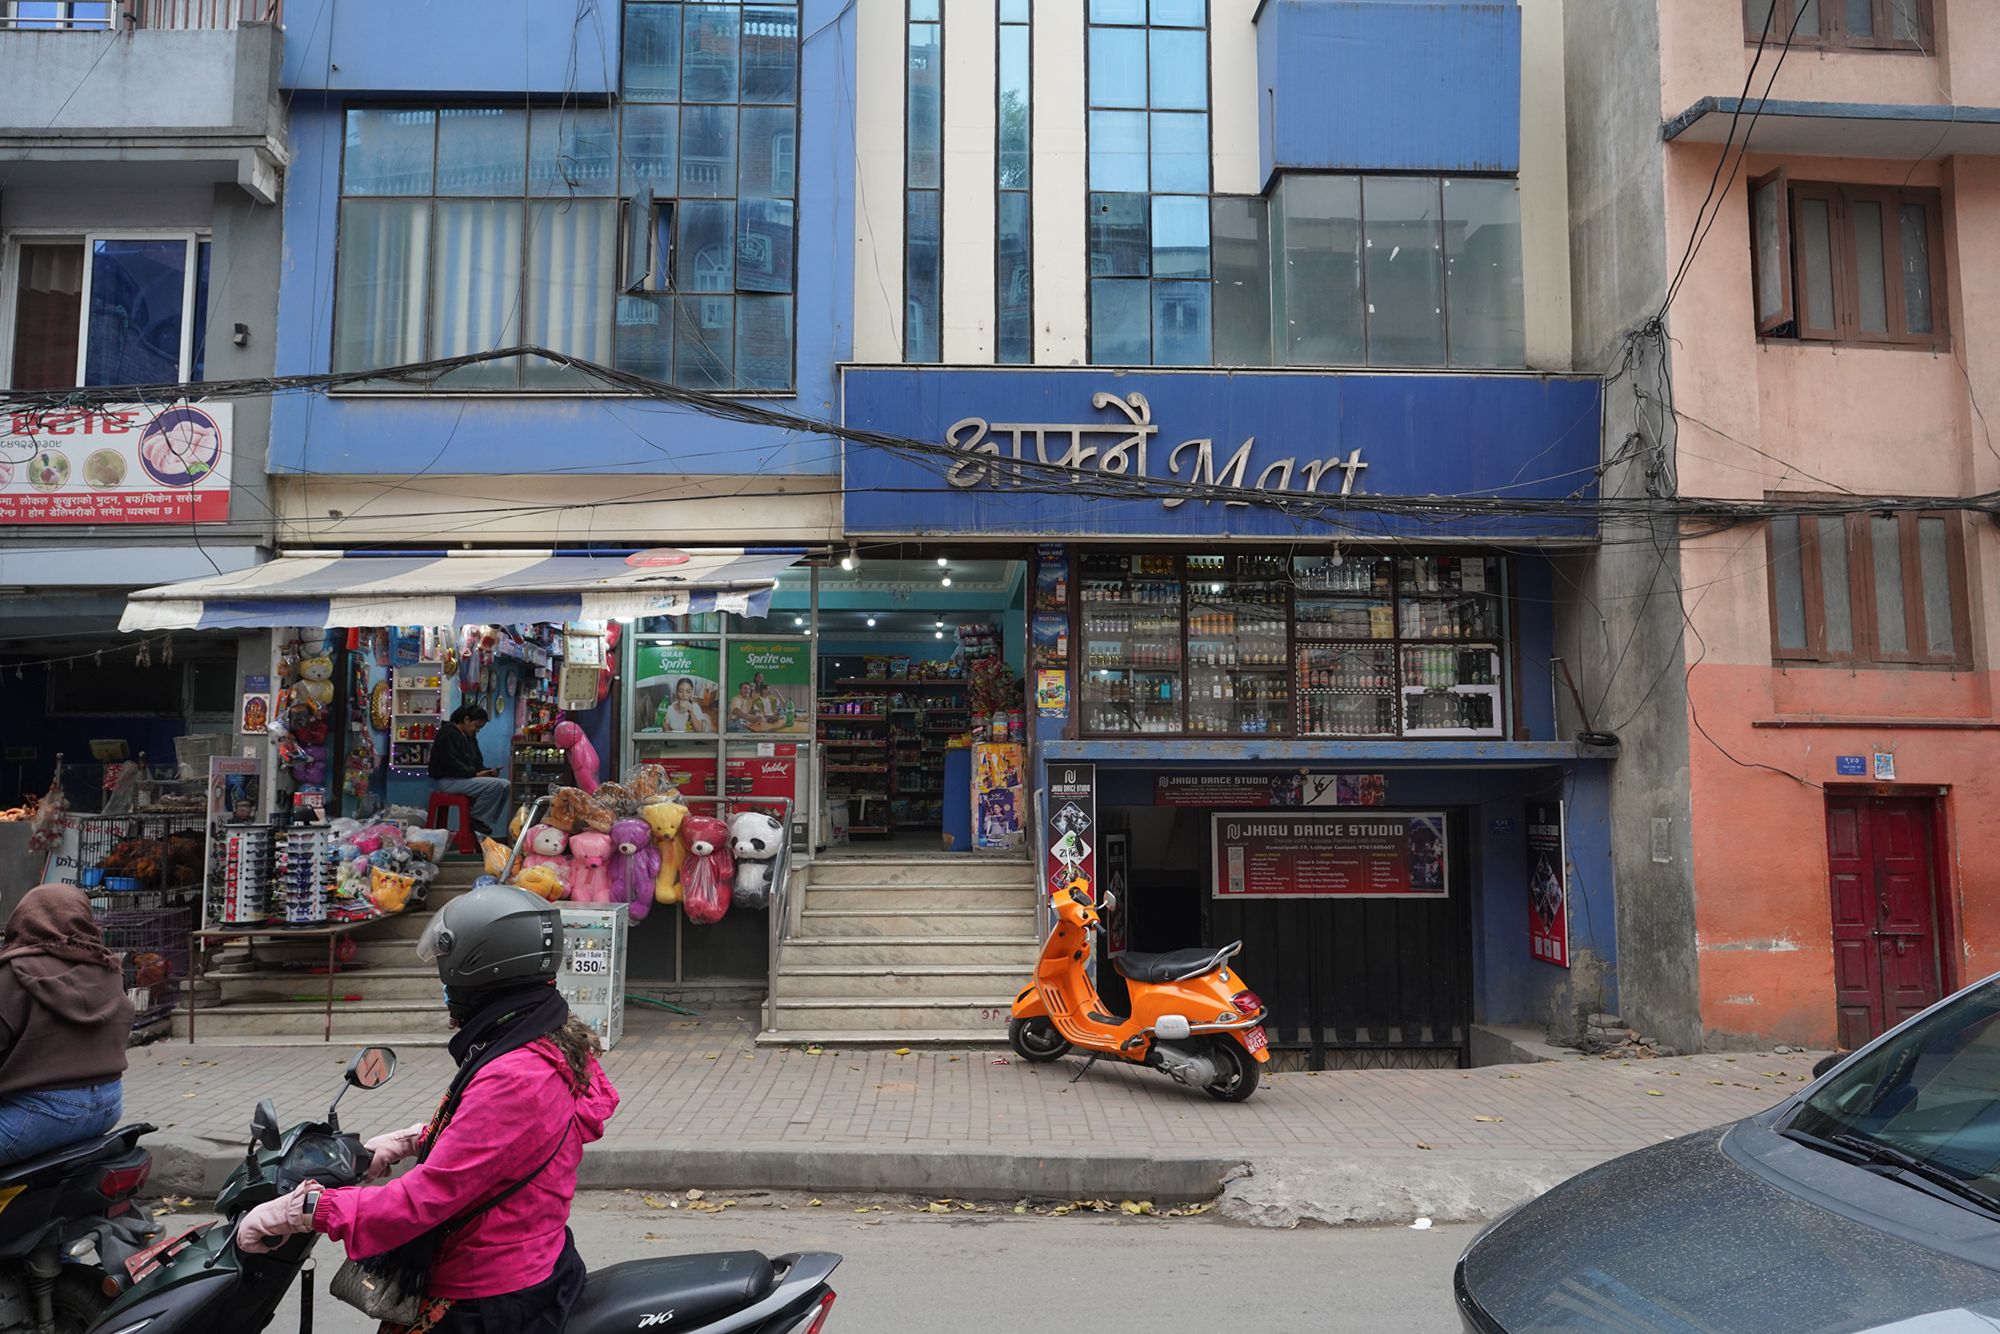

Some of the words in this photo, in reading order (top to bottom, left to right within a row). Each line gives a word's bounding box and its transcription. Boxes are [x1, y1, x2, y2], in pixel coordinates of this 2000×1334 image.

[1163, 437, 1368, 507] Mart
[20, 495, 49, 505] लोकल
[53, 495, 92, 507] कुखुराको
[659, 658, 692, 671] Sprite
[746, 652, 779, 666] Sprite
[1200, 776, 1232, 785] DANCE
[1234, 776, 1269, 785] STUDIO
[1242, 824, 1288, 837] JHIGU
[1294, 824, 1344, 837] DANCE
[1349, 824, 1404, 837] STUDIO
[575, 950, 586, 958] Sale
[590, 950, 602, 958] Sale
[575, 960, 607, 973] 350/-
